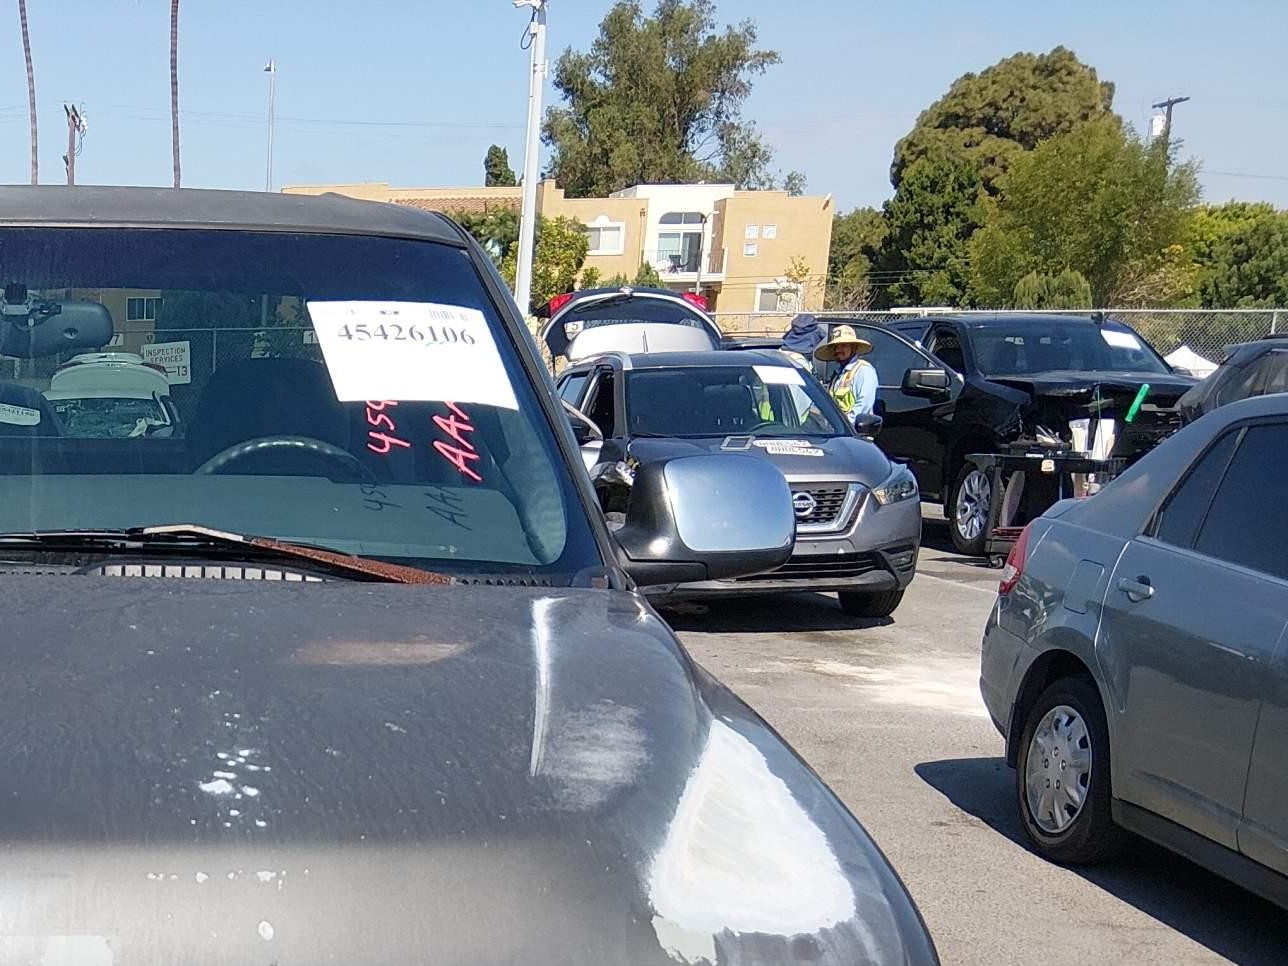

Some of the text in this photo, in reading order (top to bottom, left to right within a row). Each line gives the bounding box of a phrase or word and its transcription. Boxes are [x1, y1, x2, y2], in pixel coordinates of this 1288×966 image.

[337, 323, 476, 347] 45426106
[145, 347, 185, 357] INSPECTION
[150, 355, 183, 364] SERVICES
